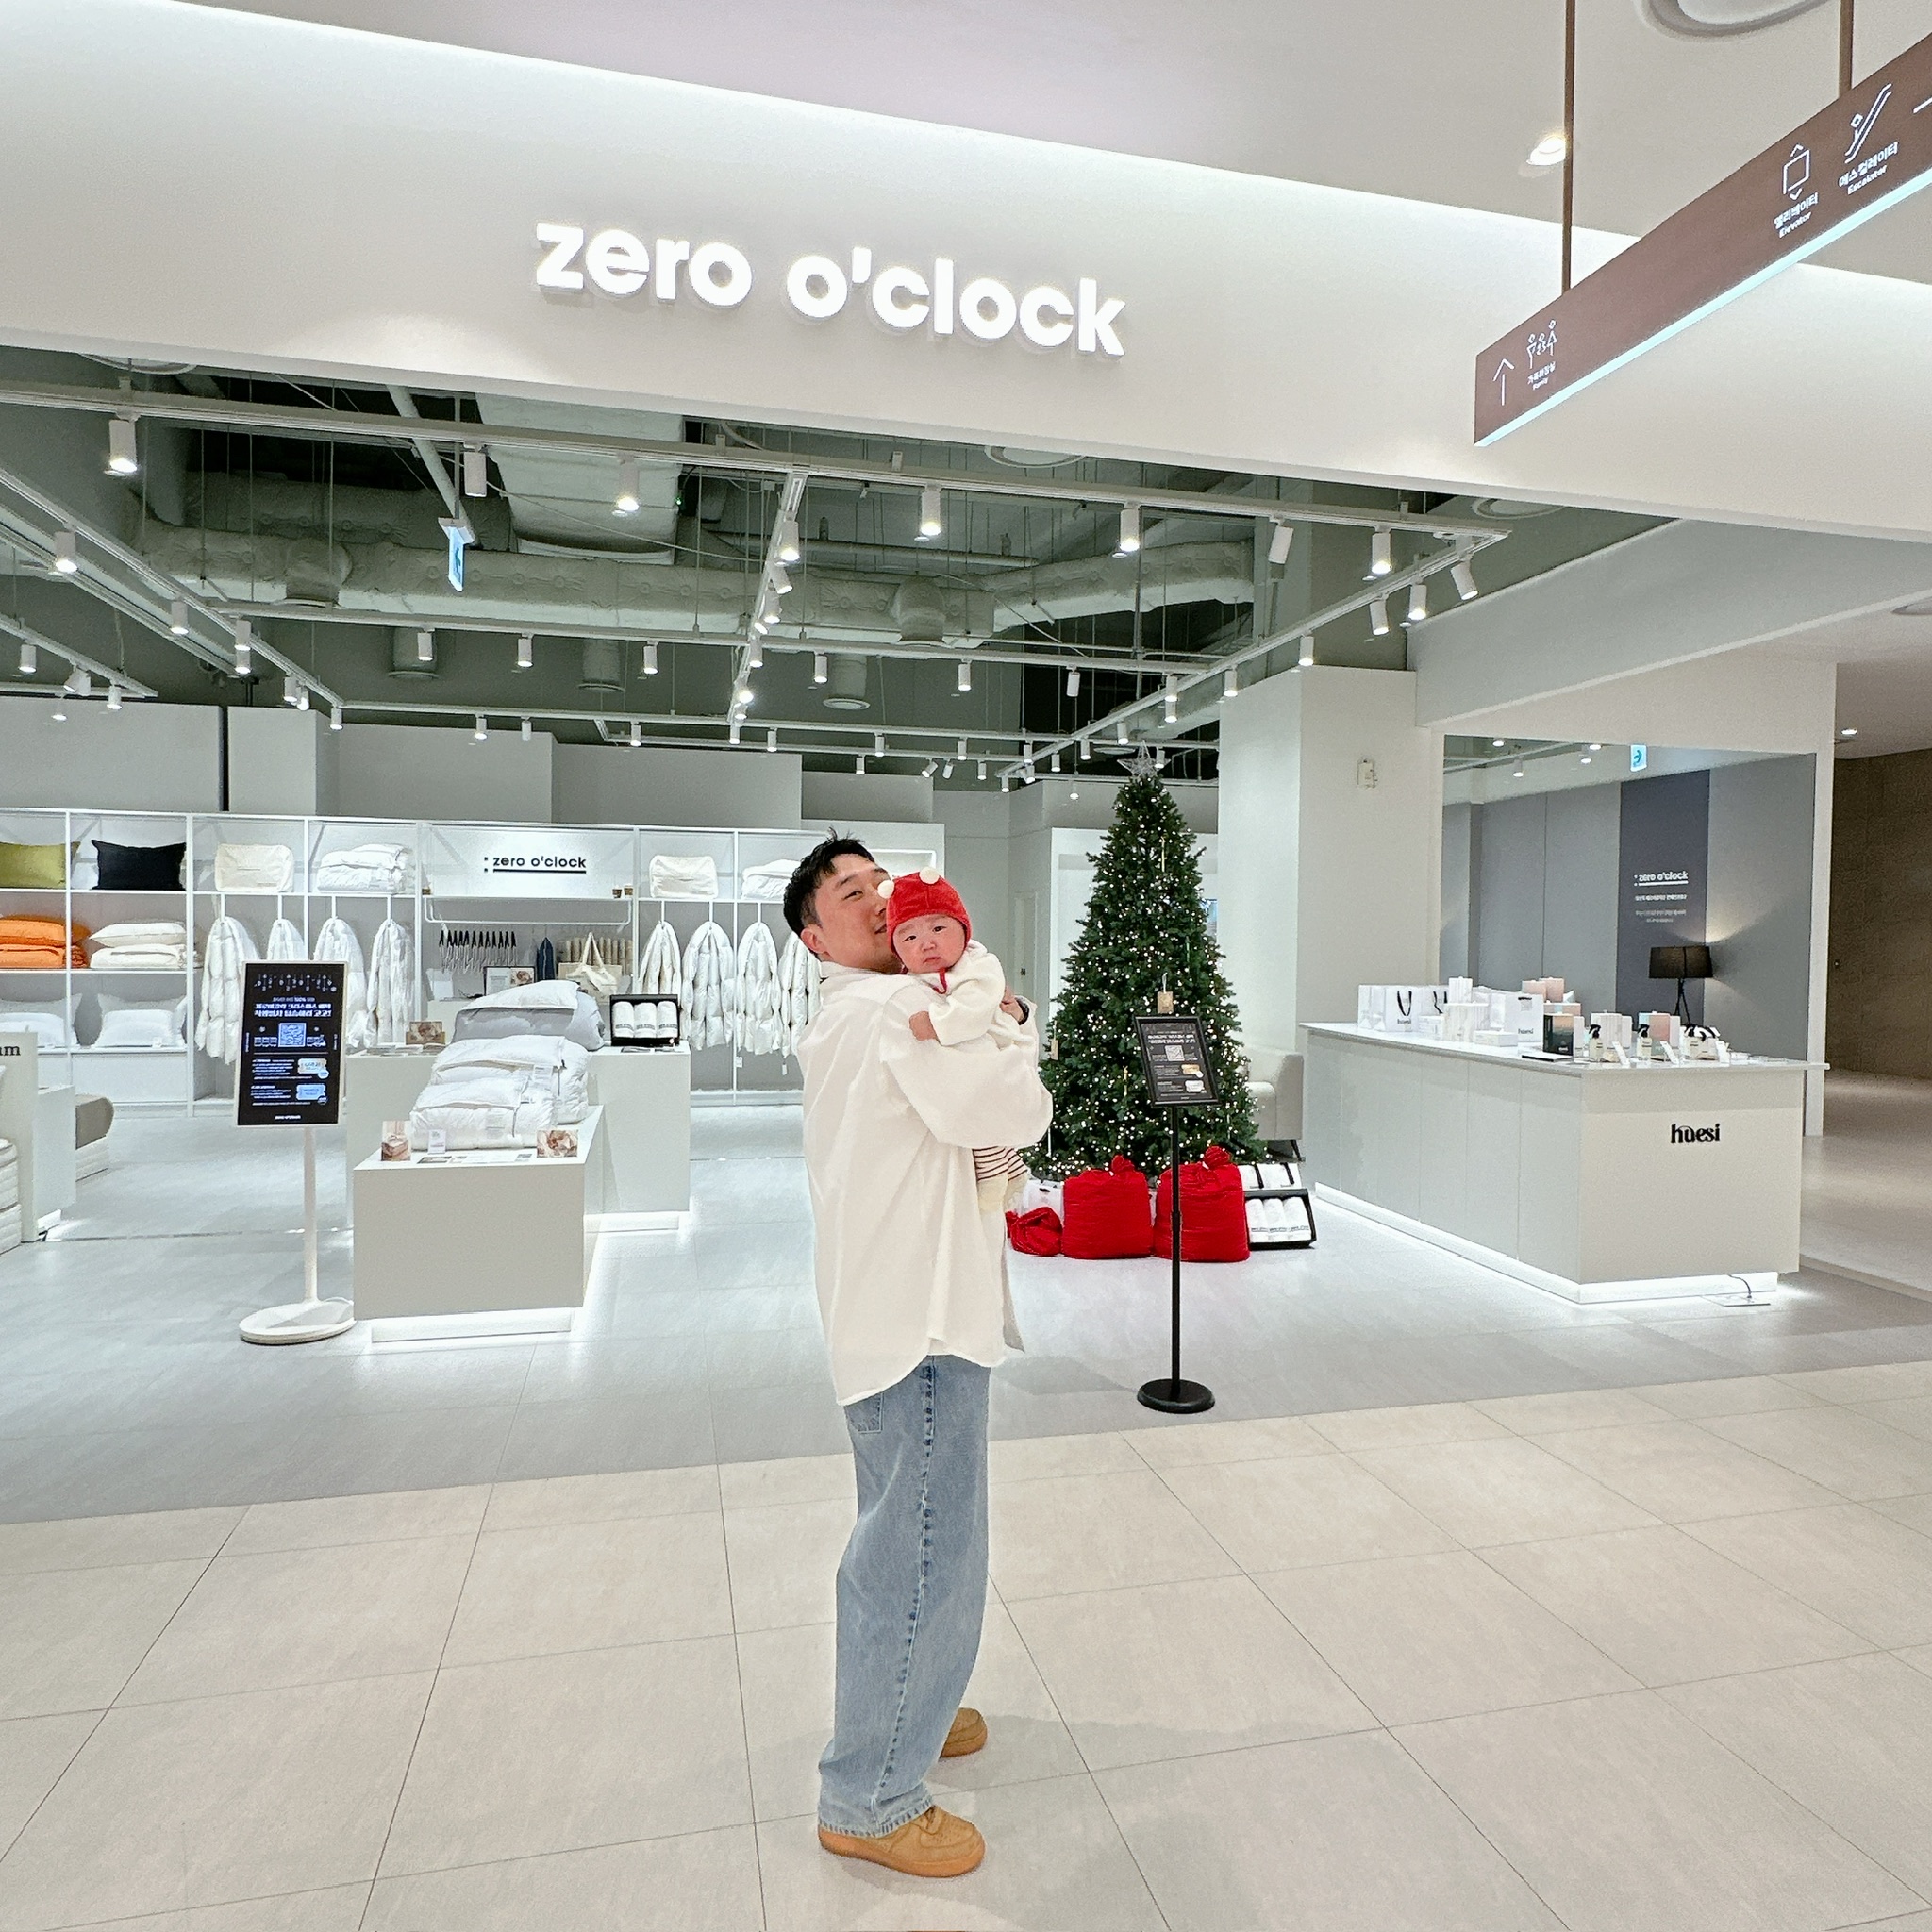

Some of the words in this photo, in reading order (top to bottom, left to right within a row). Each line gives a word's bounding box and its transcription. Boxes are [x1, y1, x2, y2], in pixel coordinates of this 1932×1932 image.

[1839, 141, 1898, 187] 에스컬레이터
[1848, 164, 1888, 194] Escalator
[1774, 192, 1819, 230] 엘리베이터
[536, 221, 754, 308] zero
[786, 246, 1126, 358] o'clock
[492, 857, 525, 867] zero
[530, 855, 587, 868] o'clock
[1639, 874, 1657, 882] zero
[1657, 870, 1689, 881] o'clock
[1670, 1123, 1721, 1144] huesi
